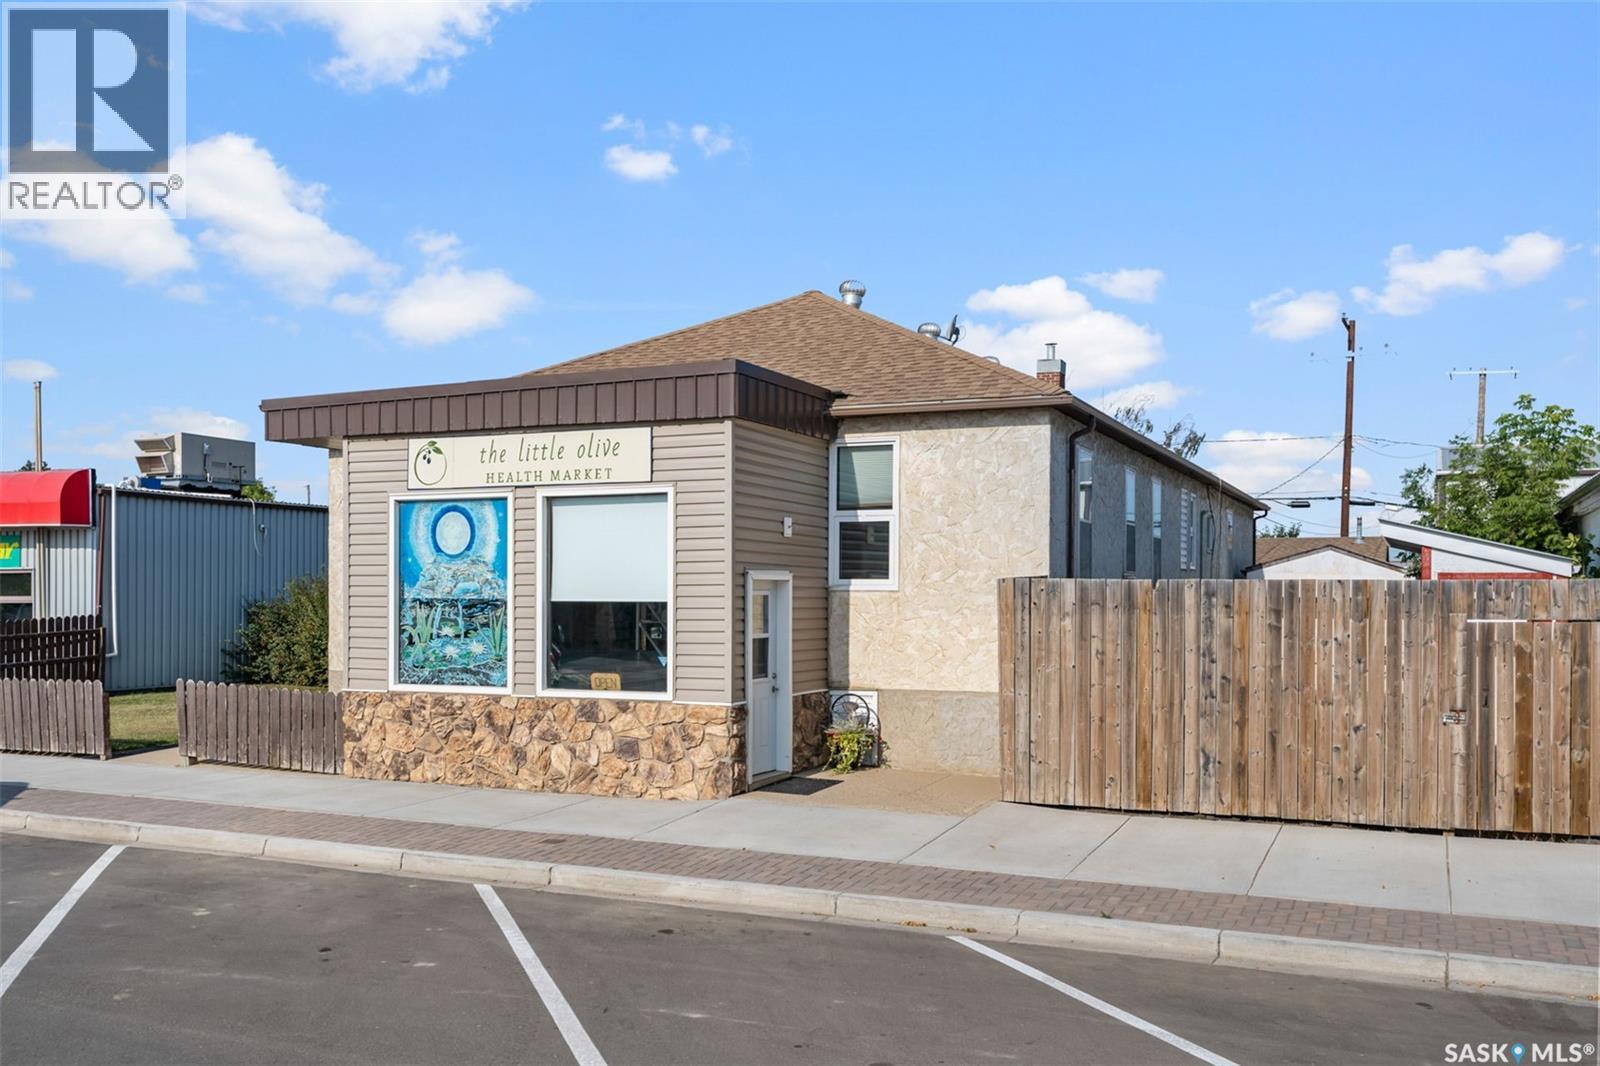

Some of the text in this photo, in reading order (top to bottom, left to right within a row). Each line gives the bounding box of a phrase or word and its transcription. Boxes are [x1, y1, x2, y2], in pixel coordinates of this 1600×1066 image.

[480, 432, 621, 464] the little olive
[486, 467, 613, 484] HEALTH MARKET
[594, 677, 618, 689] OPEN
